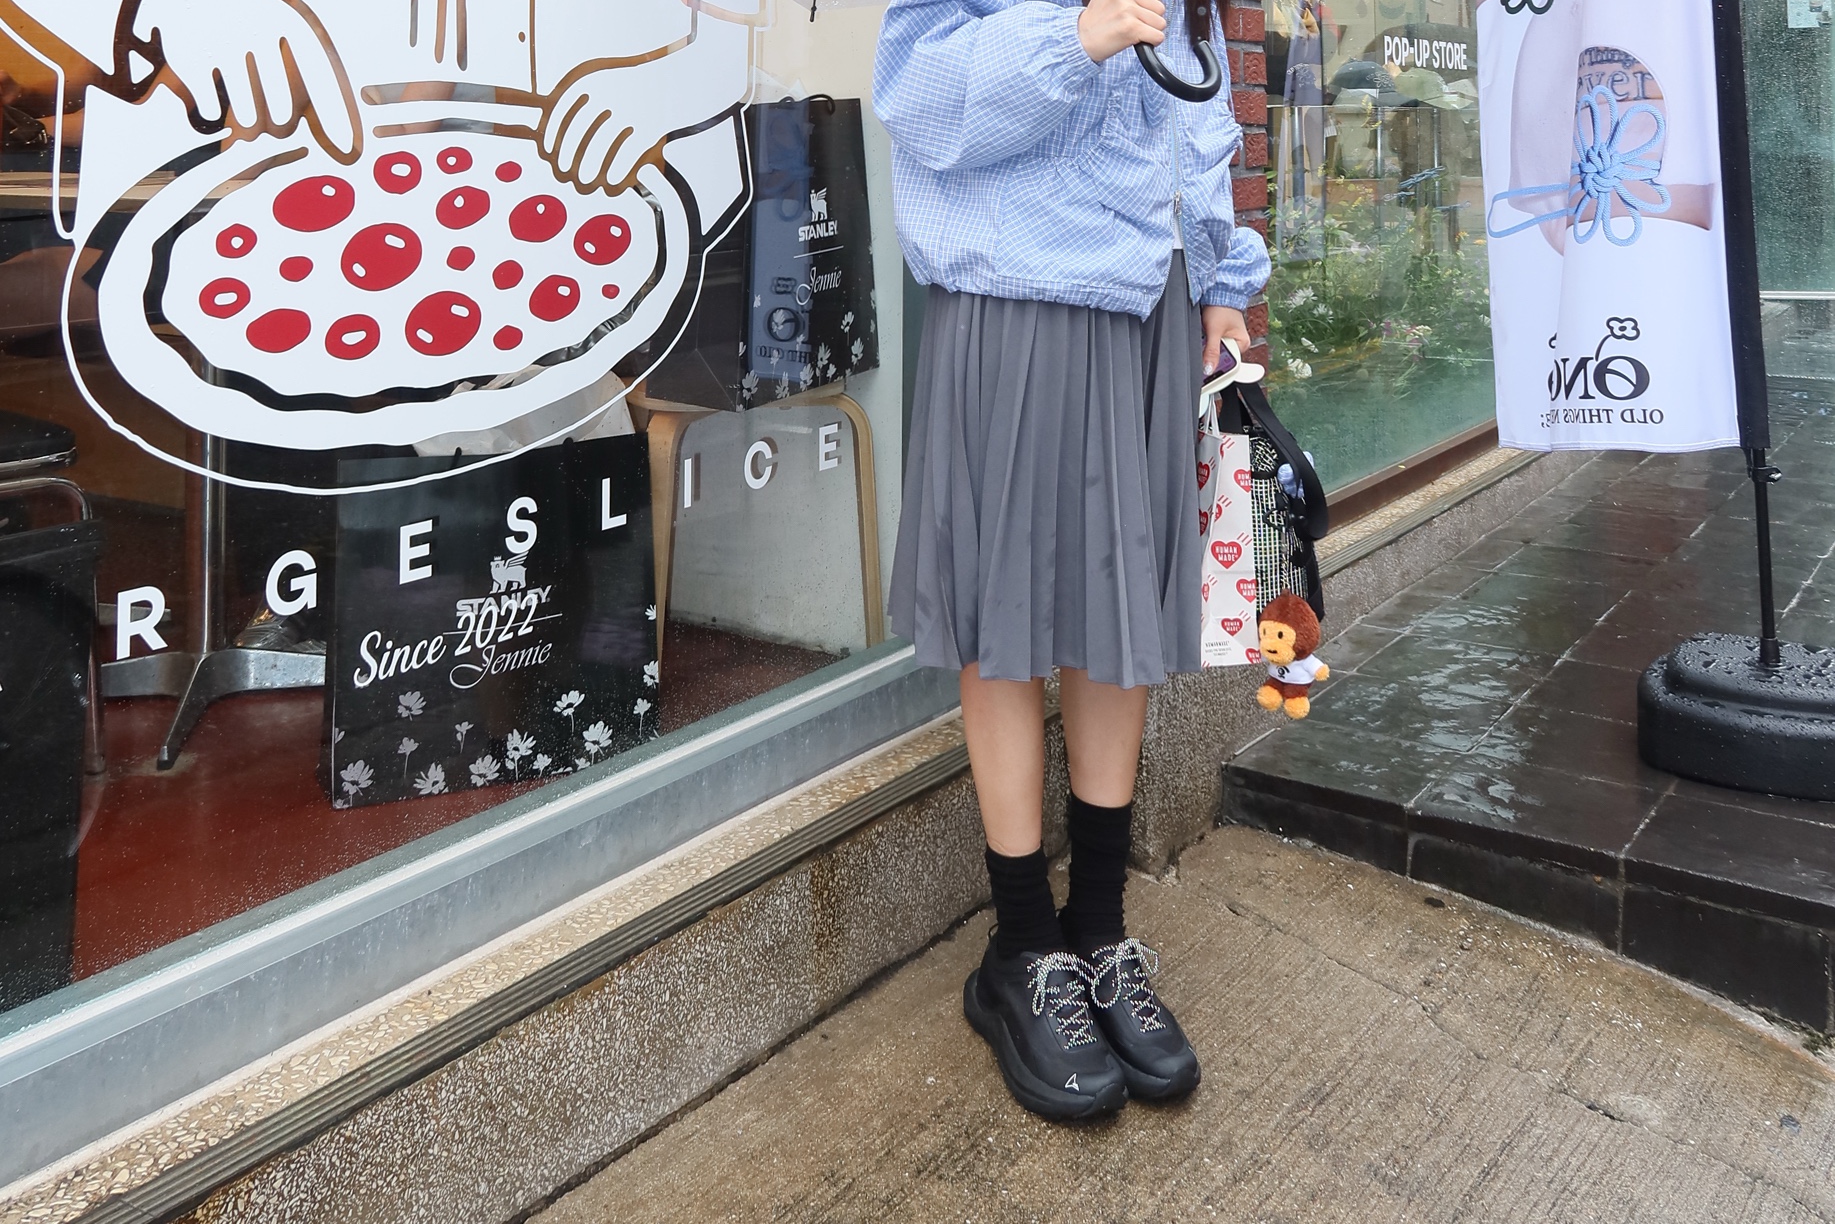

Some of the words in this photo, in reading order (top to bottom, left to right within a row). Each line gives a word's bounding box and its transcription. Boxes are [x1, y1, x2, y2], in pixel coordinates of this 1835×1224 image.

[1384, 35, 1429, 67] POP-UP
[1432, 41, 1467, 70] STORE
[798, 219, 839, 242] STANLEY
[796, 266, 841, 305] Jennie
[505, 423, 840, 553] SLICE
[1215, 545, 1238, 554] HUMAN
[1218, 554, 1235, 562] MADE
[353, 631, 447, 687] Since
[454, 594, 538, 656] 2022
[450, 639, 553, 690] Jennie
